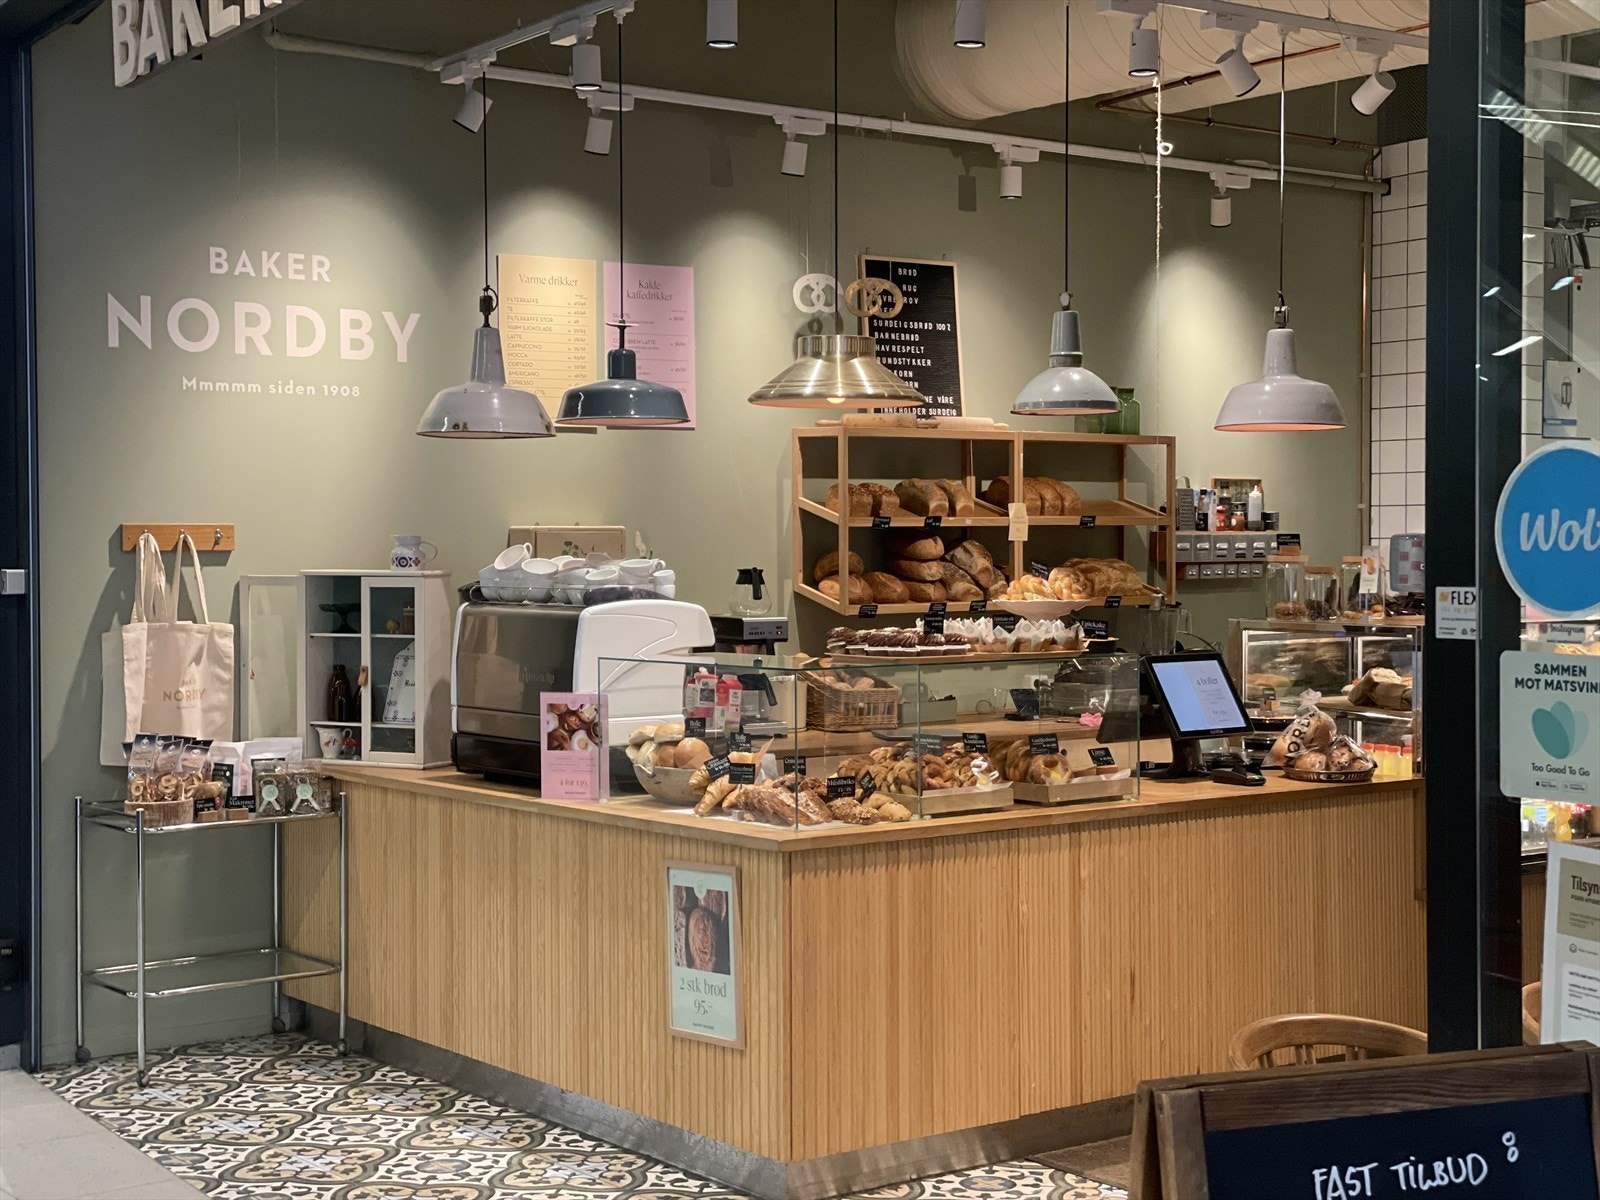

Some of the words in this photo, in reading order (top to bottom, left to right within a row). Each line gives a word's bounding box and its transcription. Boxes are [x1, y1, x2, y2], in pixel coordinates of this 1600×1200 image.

[209, 246, 331, 282] BAKER
[518, 273, 547, 285] Varme
[548, 275, 578, 287] drikker
[638, 279, 662, 290] Kalde
[626, 289, 673, 301] kaffedrikker
[107, 292, 421, 363] NORDBY
[875, 344, 925, 354] HAVRESPELT
[182, 376, 261, 393] Mmmmm
[269, 379, 316, 396] siden
[322, 384, 360, 397] 1908
[1549, 623, 1585, 637] Instagram
[1534, 663, 1587, 677] SAMMEN
[1514, 677, 1541, 690] MOT
[1544, 679, 1600, 694] MATSVIN
[1531, 762, 1544, 772] Too
[1546, 764, 1567, 774] Good
[1568, 766, 1577, 775] To
[1578, 767, 1591, 777] Go
[1570, 874, 1600, 897] Tilsyn
[680, 977, 686, 990] 2
[686, 977, 702, 994] stk
[1312, 1162, 1379, 1200] FAST
